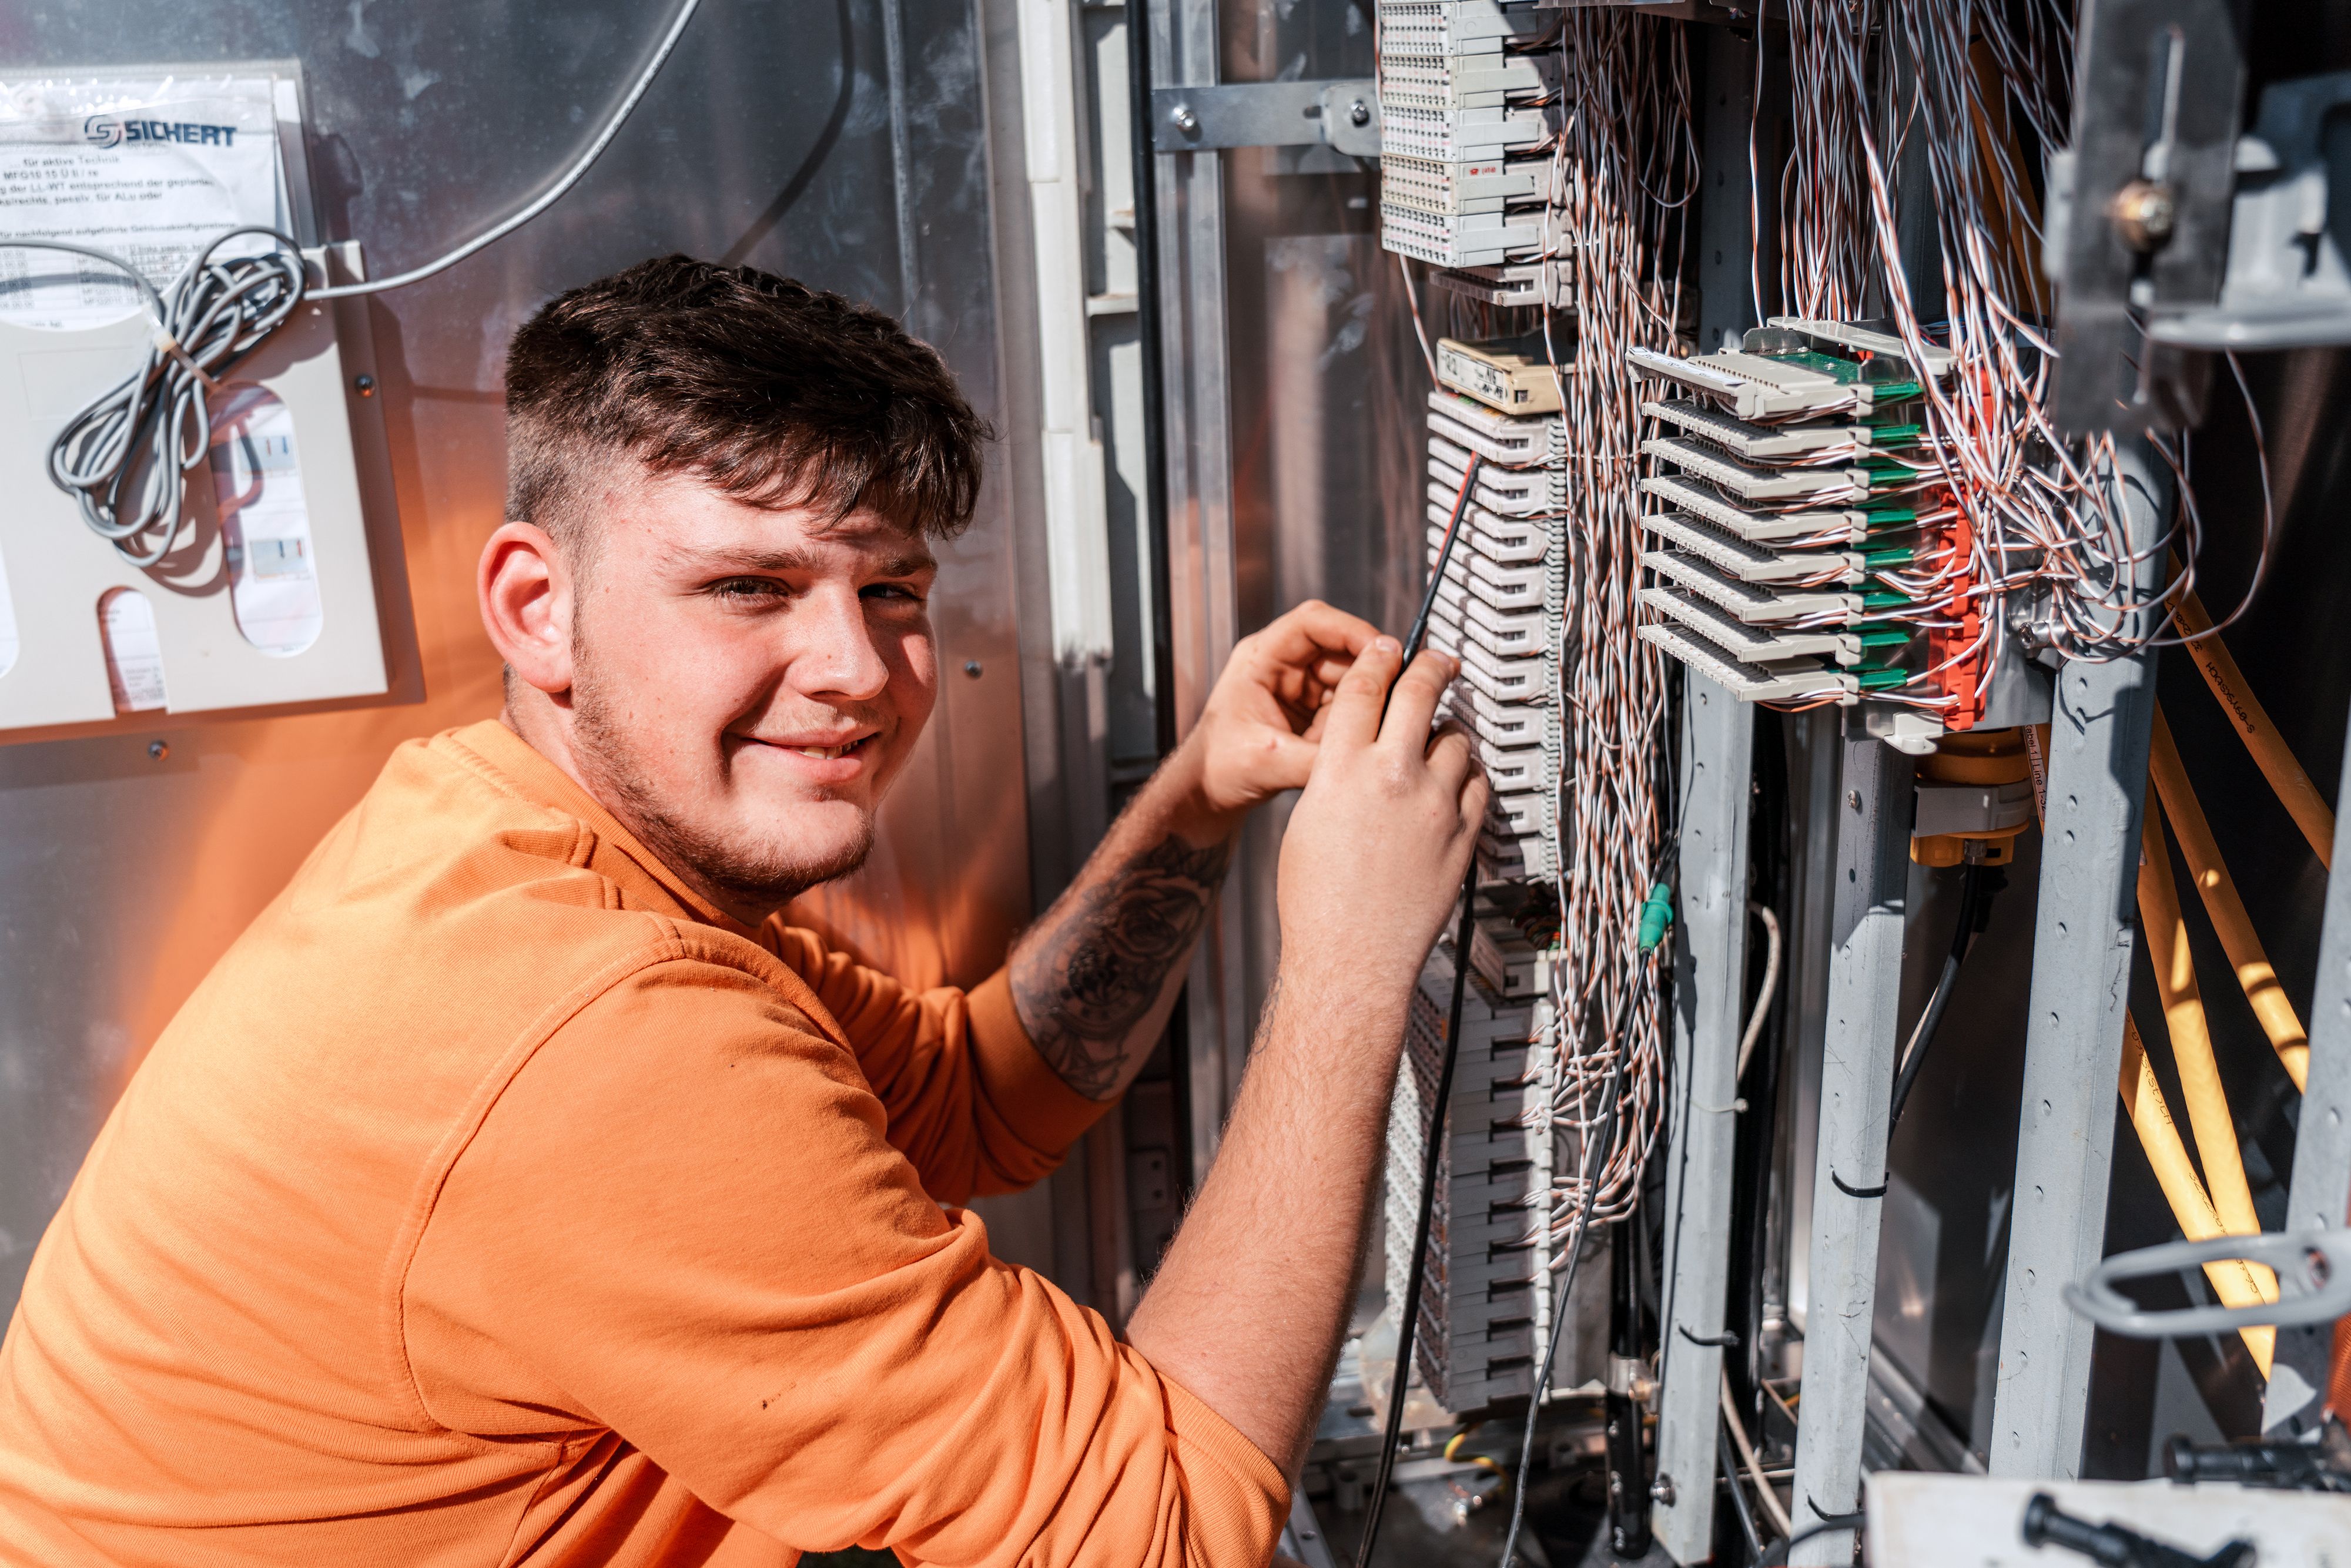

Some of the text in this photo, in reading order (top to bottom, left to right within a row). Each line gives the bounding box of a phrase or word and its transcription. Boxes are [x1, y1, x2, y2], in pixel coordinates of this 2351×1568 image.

[125, 120, 236, 146] SICHERT
[78, 155, 120, 165] Technik
[2032, 764, 2043, 786] Line
